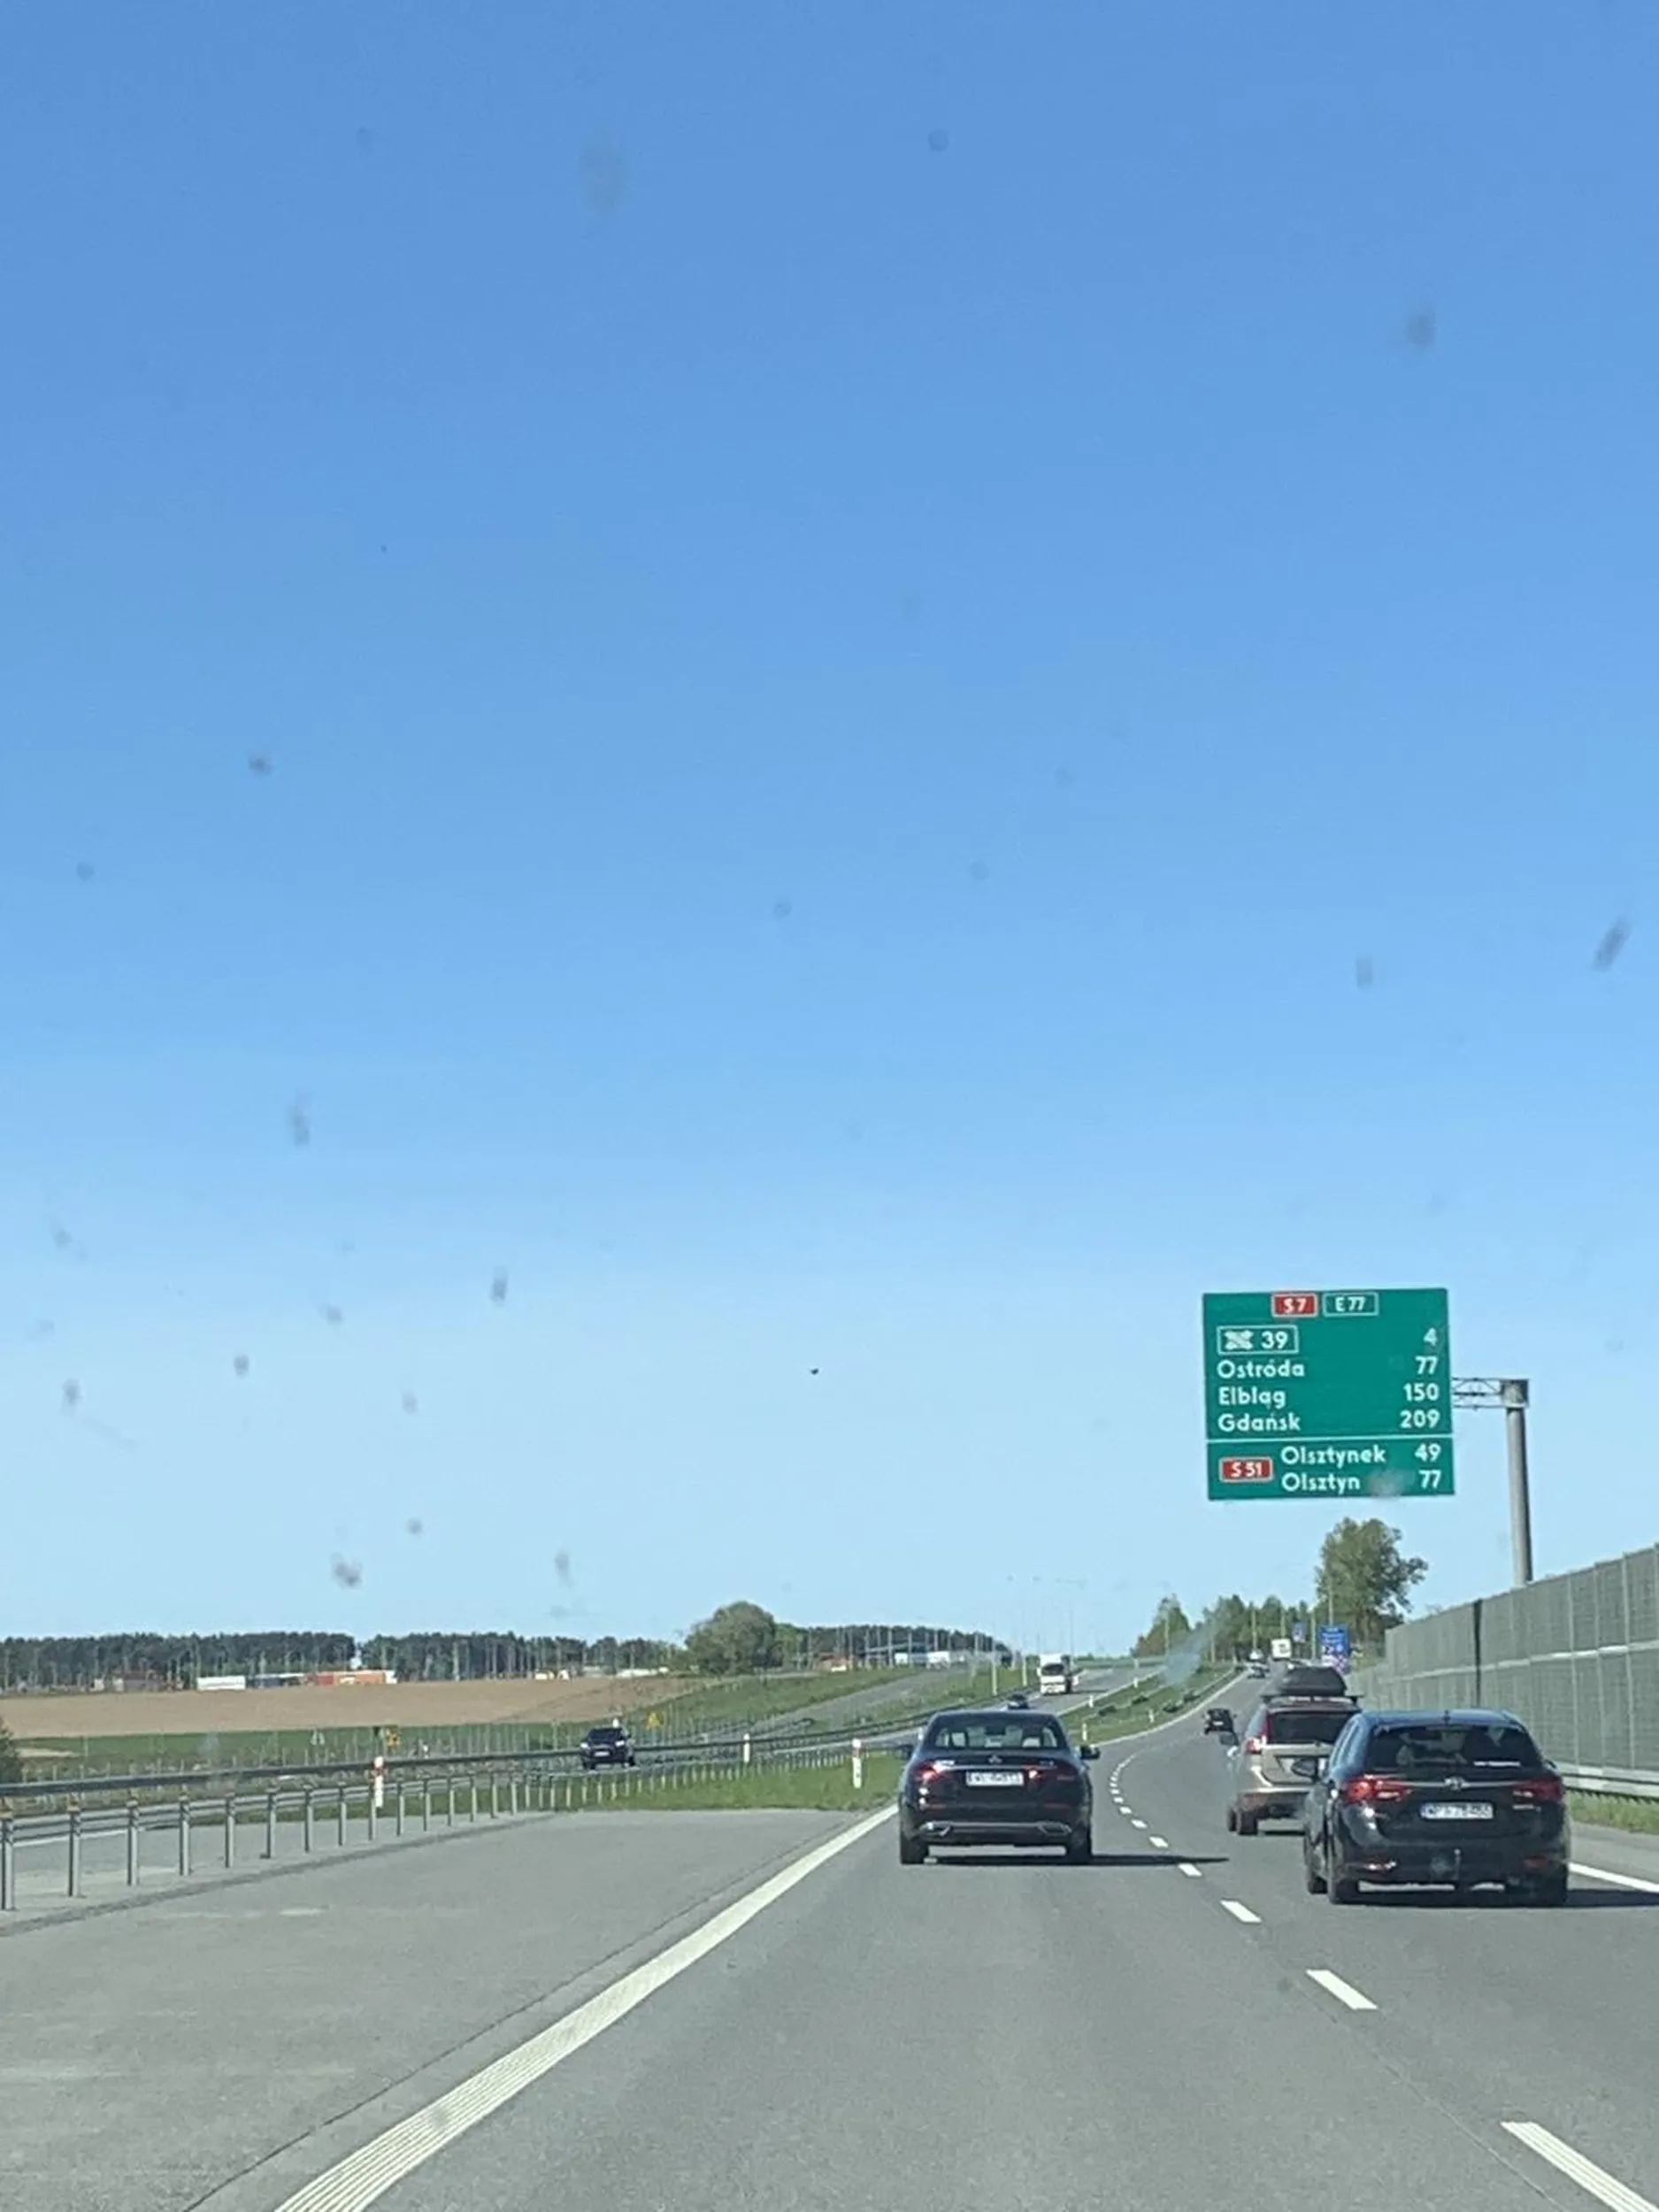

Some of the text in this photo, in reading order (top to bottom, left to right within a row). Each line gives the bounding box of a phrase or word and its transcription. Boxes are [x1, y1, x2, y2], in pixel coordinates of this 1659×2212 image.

[1261, 1328, 1437, 1348] 39 4
[1217, 1356, 1438, 1379] Ostróda 77
[1218, 1384, 1439, 1409] Elbląg 150
[1218, 1410, 1440, 1432] Gdańsk 209
[1281, 1444, 1440, 1468] Olsztynek 49
[1283, 1471, 1441, 1494] Olsztyn 77
